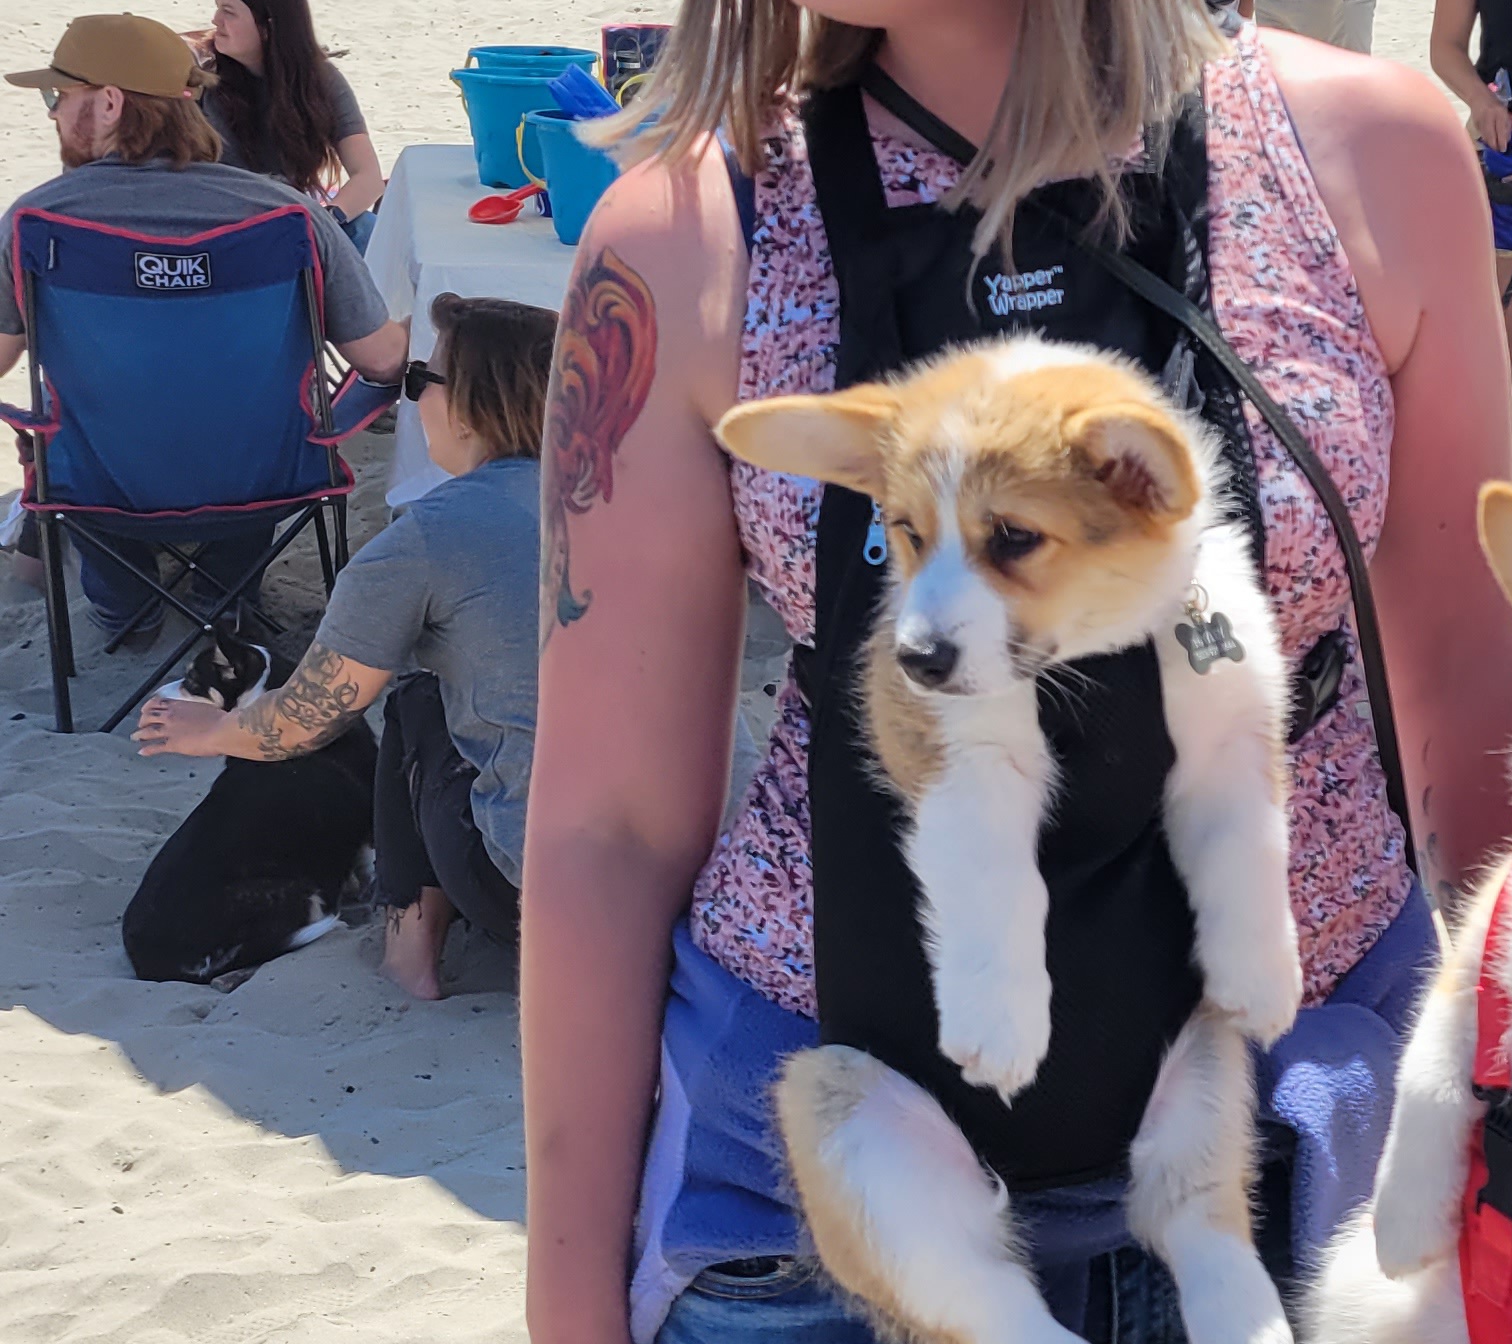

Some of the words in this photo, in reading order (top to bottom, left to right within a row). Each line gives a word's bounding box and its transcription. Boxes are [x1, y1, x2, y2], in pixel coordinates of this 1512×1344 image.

[139, 256, 204, 275] QUIK
[140, 274, 208, 287] CHAIR
[988, 289, 1065, 315] Wrapper
